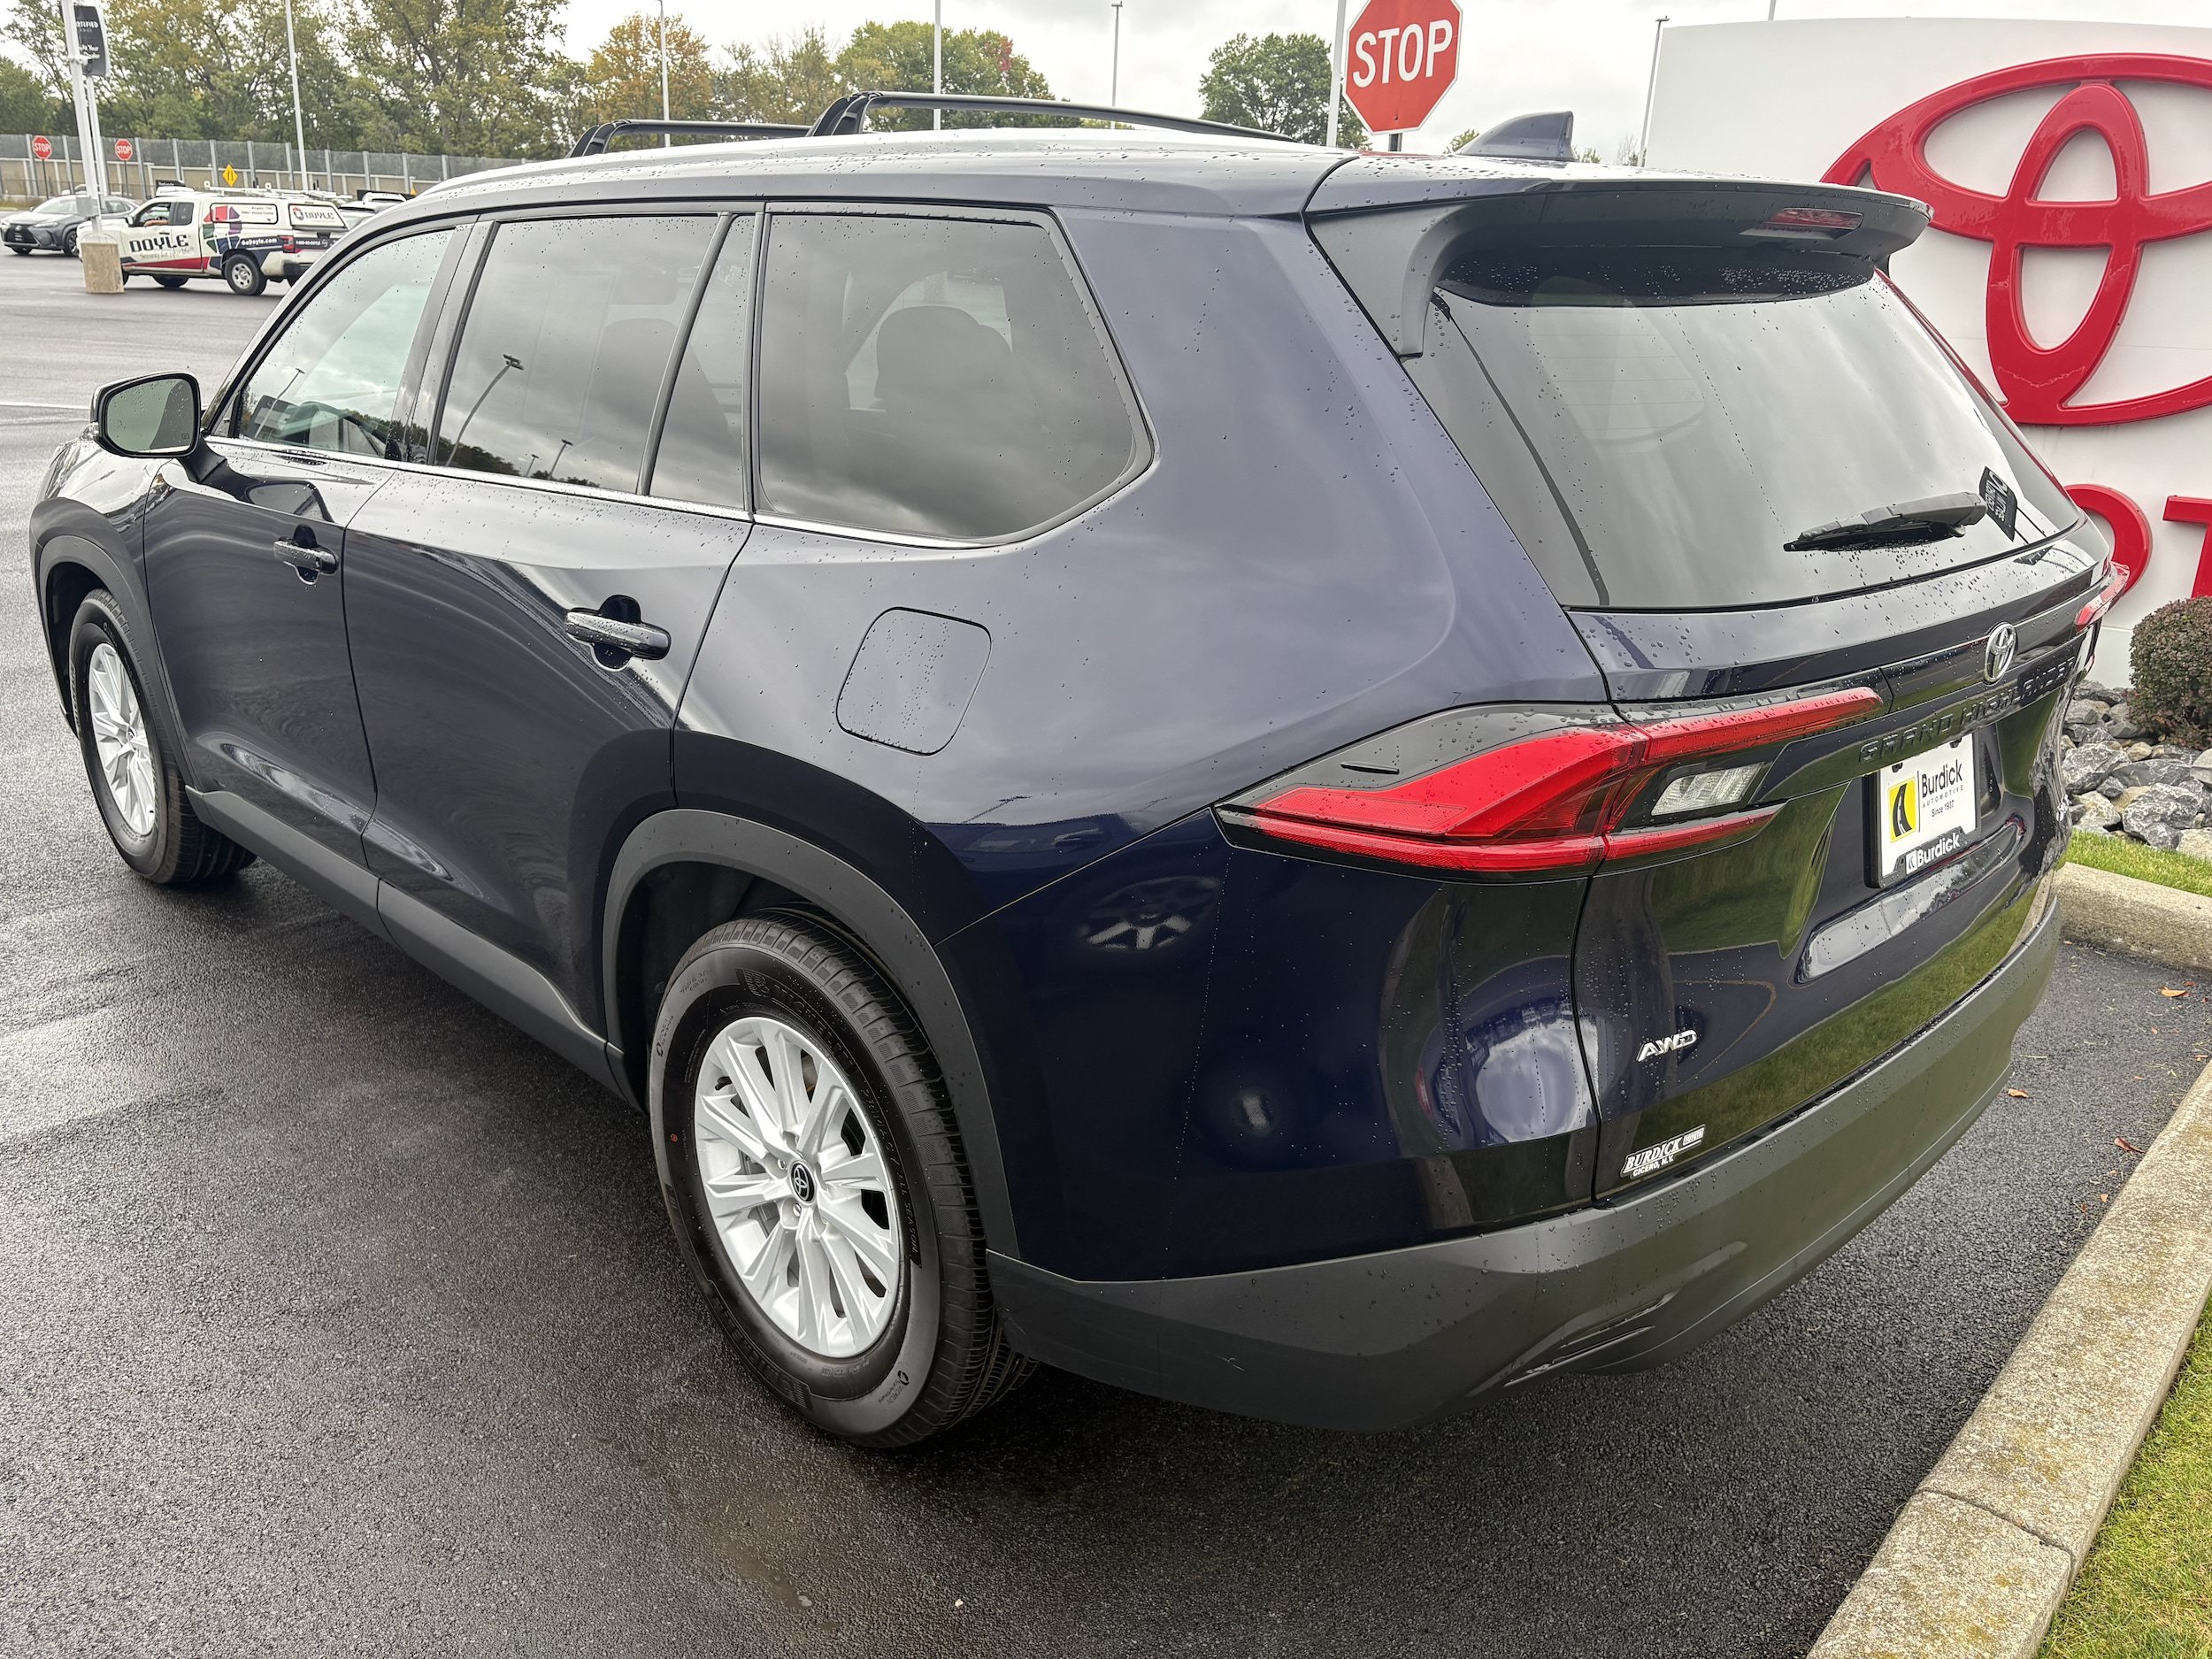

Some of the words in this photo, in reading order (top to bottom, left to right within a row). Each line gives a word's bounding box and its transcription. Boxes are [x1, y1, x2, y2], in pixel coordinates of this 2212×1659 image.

[1352, 19, 1453, 88] STOP
[34, 142, 51, 152] STOP
[116, 145, 132, 154] STOP
[129, 234, 188, 253] DOYLE
[1859, 712, 1954, 764] GRAND
[1921, 759, 1962, 798] Burdick
[1922, 785, 1964, 809] AUTOMOTIVE
[1931, 806, 1944, 818] Since
[1916, 832, 1961, 867] Burdick
[1637, 1029, 1698, 1063] AWD
[1624, 1136, 1683, 1171] BURDICK
